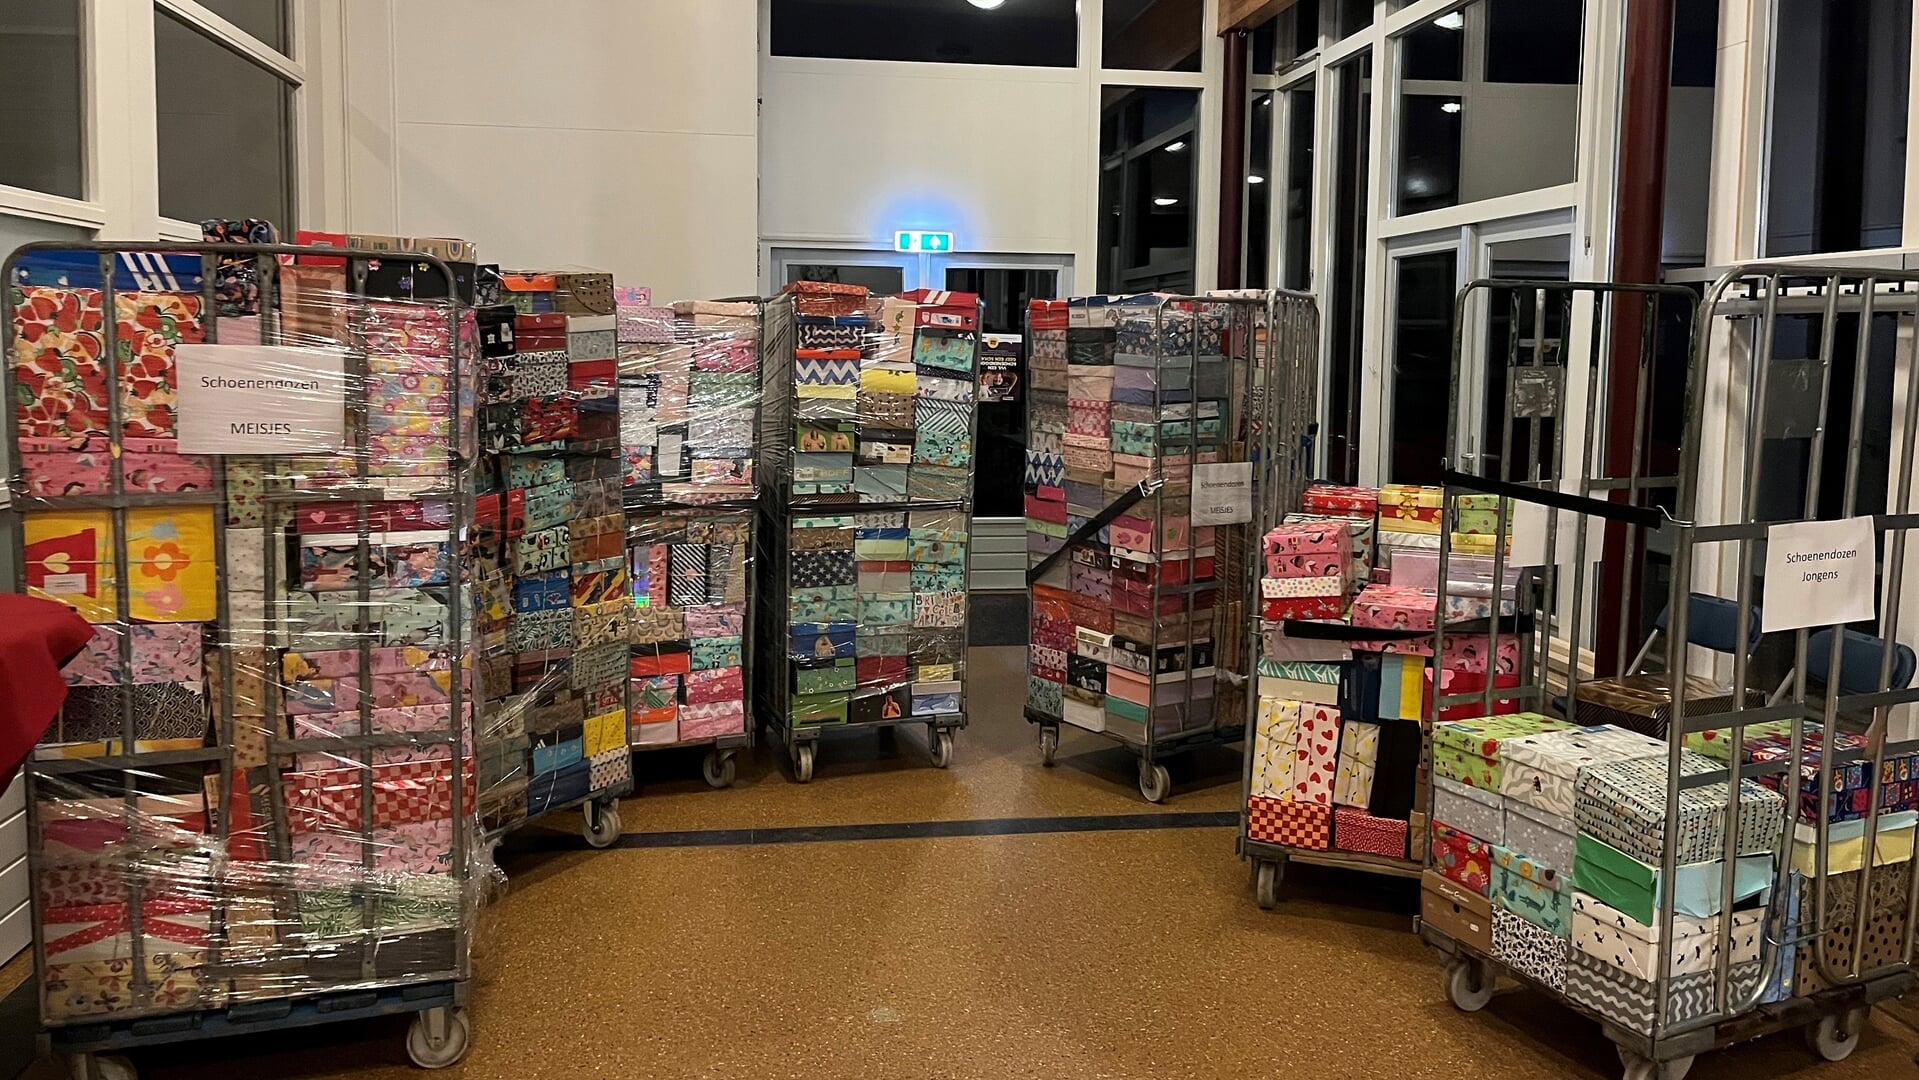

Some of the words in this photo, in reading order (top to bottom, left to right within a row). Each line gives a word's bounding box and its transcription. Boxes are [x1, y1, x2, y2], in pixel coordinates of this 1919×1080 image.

[200, 376, 319, 390] Schoenendozen
[231, 422, 291, 435] MEISJES
[1786, 549, 1857, 564] Schoenendozen
[1802, 570, 1839, 583] Jongens
